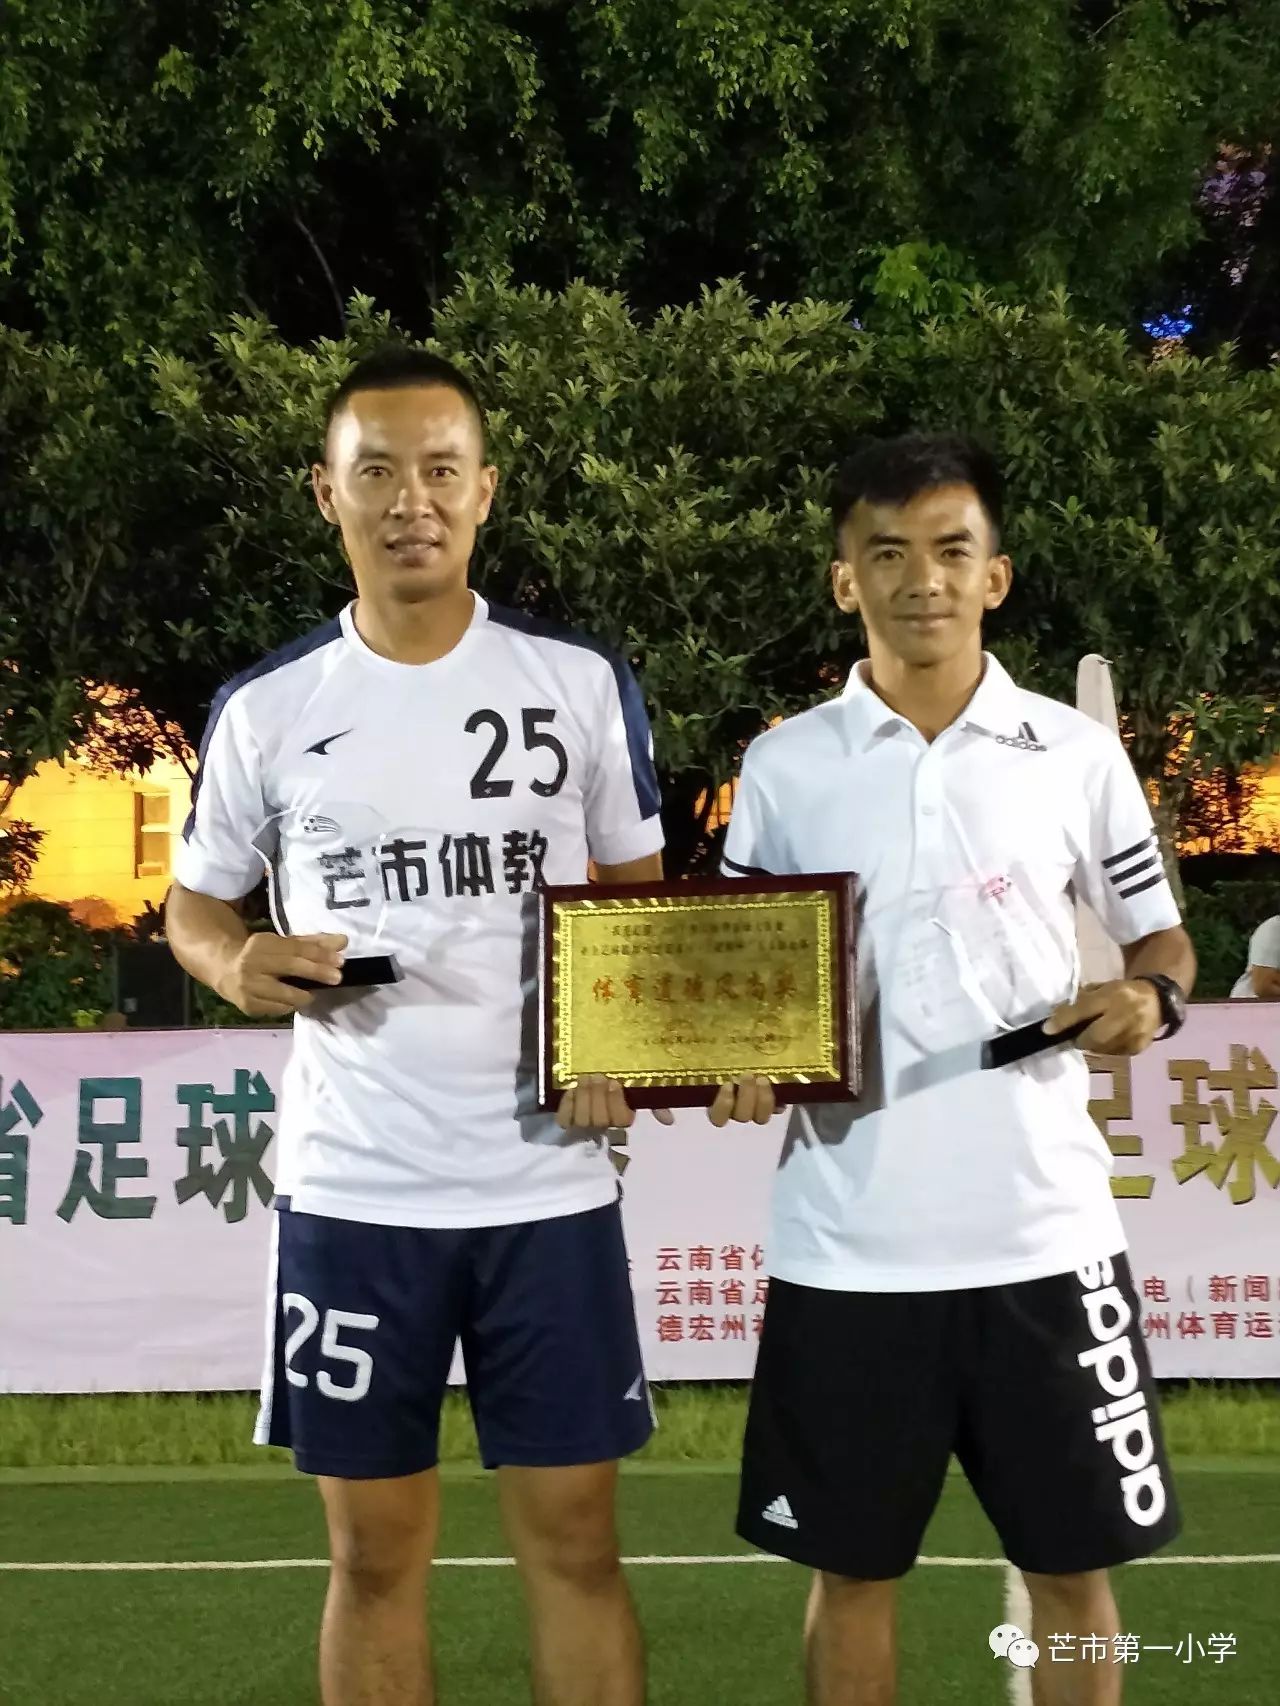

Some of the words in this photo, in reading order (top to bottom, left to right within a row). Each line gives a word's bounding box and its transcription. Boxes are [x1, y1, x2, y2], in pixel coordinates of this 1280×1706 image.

[465, 708, 568, 799] 25
[318, 829, 550, 910] 芒市体教
[1143, 1275, 1280, 1303] 电（新闻
[1143, 1311, 1280, 1340] 州体育运
[282, 1292, 380, 1402] 25
